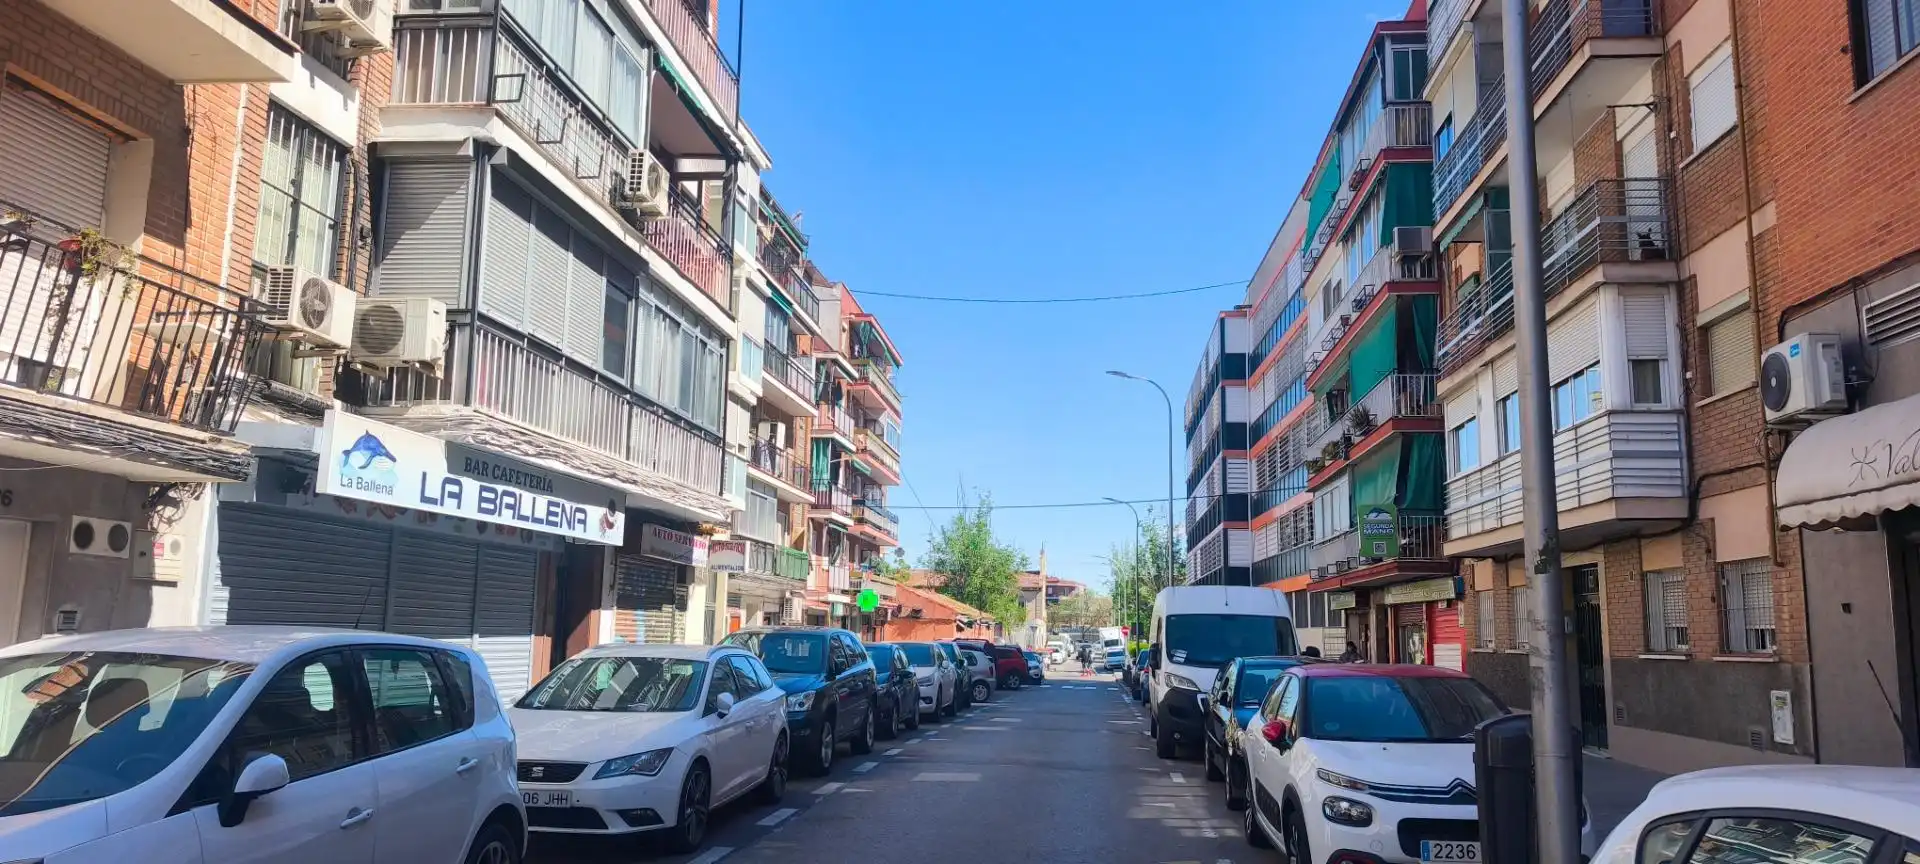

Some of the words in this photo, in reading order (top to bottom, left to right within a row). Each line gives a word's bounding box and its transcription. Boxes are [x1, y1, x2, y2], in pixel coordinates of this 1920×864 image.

[340, 473, 353, 489] La
[355, 476, 394, 496] Ballena
[463, 456, 490, 478] BAR
[491, 464, 554, 494] CAFETERÍA
[0, 488, 14, 508] 6
[419, 471, 464, 510] LA
[477, 483, 588, 533] BALLENA
[652, 527, 674, 541] AUTO
[519, 792, 539, 805] 06
[543, 792, 569, 806] JHH
[1433, 843, 1476, 860] 2236
